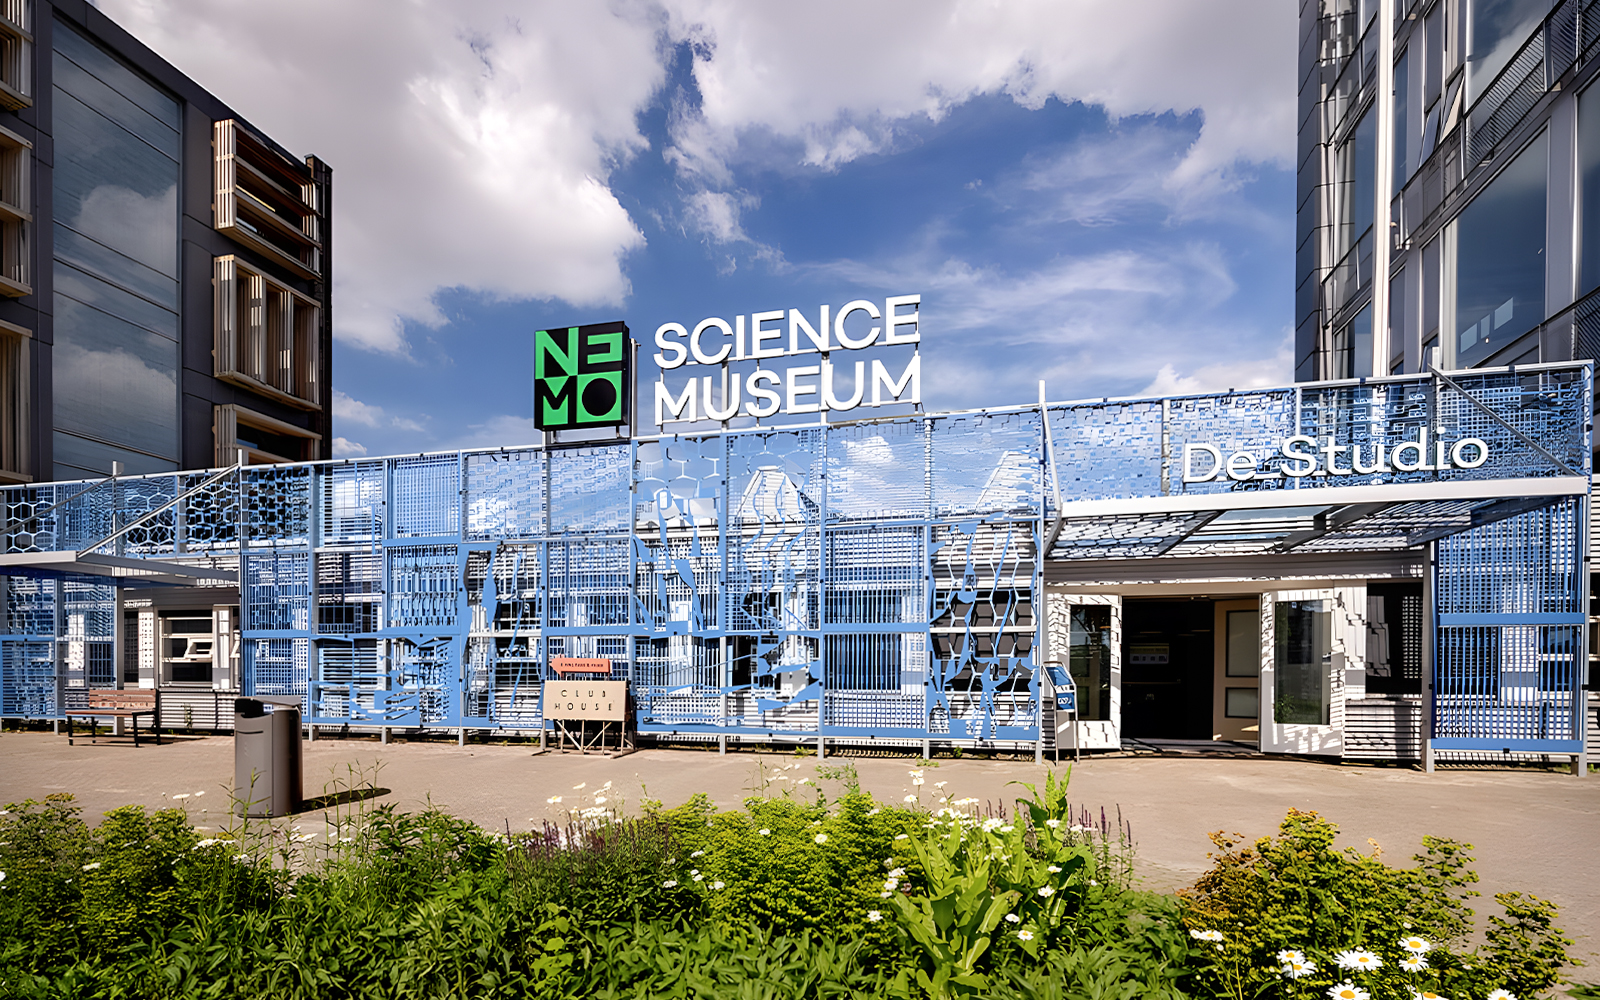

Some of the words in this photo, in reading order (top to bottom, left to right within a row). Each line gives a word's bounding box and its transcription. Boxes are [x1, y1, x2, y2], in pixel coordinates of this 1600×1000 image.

[653, 293, 921, 370] SCIENCE
[654, 355, 921, 426] MUSEUM
[1183, 442, 1258, 483] De
[1280, 426, 1489, 477] Studio
[555, 703, 613, 711] HOUSE
[561, 689, 606, 698] CLUB
